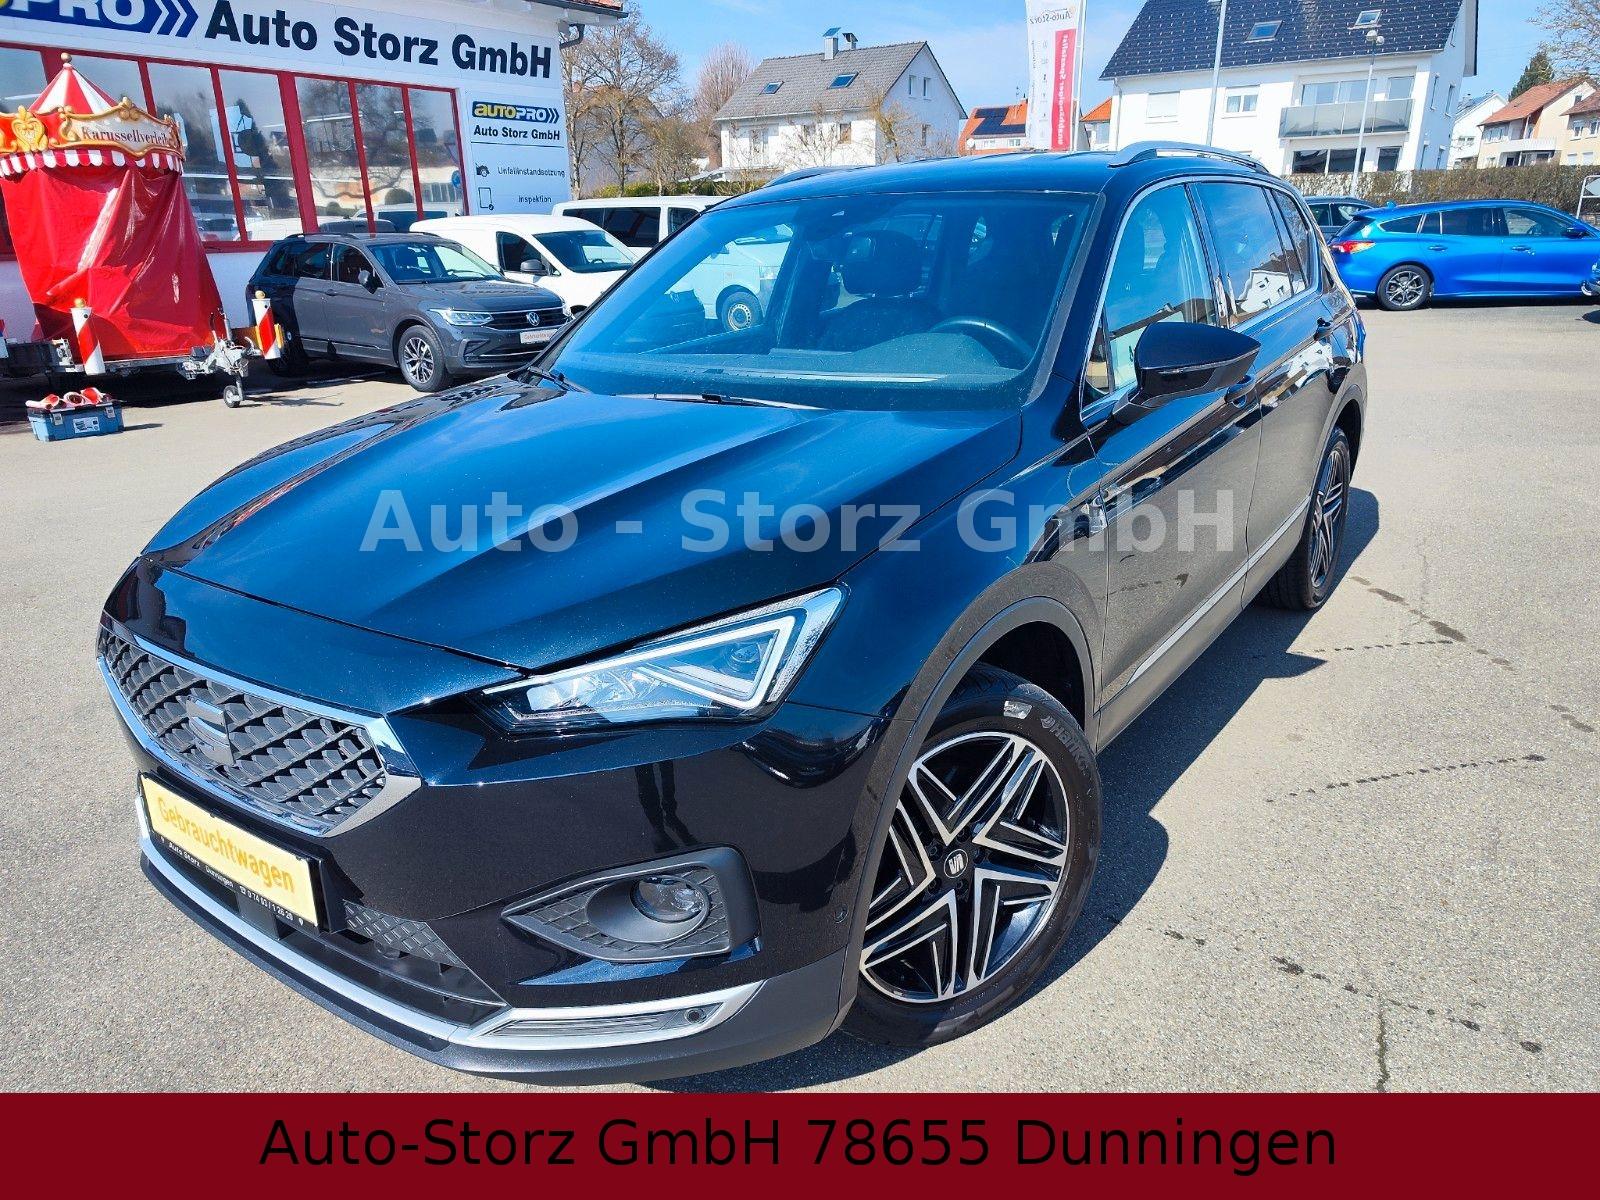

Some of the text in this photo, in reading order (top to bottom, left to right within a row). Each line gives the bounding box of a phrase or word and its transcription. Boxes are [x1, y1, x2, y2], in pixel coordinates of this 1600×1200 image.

[205, 0, 318, 51] Auto
[333, 16, 439, 66] Storz
[451, 33, 552, 79] GmbH
[474, 125, 560, 140] Auto Storz GmbH
[518, 195, 552, 204] Inspektion
[157, 796, 295, 893] Gebrauchtwagen
[168, 843, 183, 857] Auto
[183, 852, 200, 866] Storz
